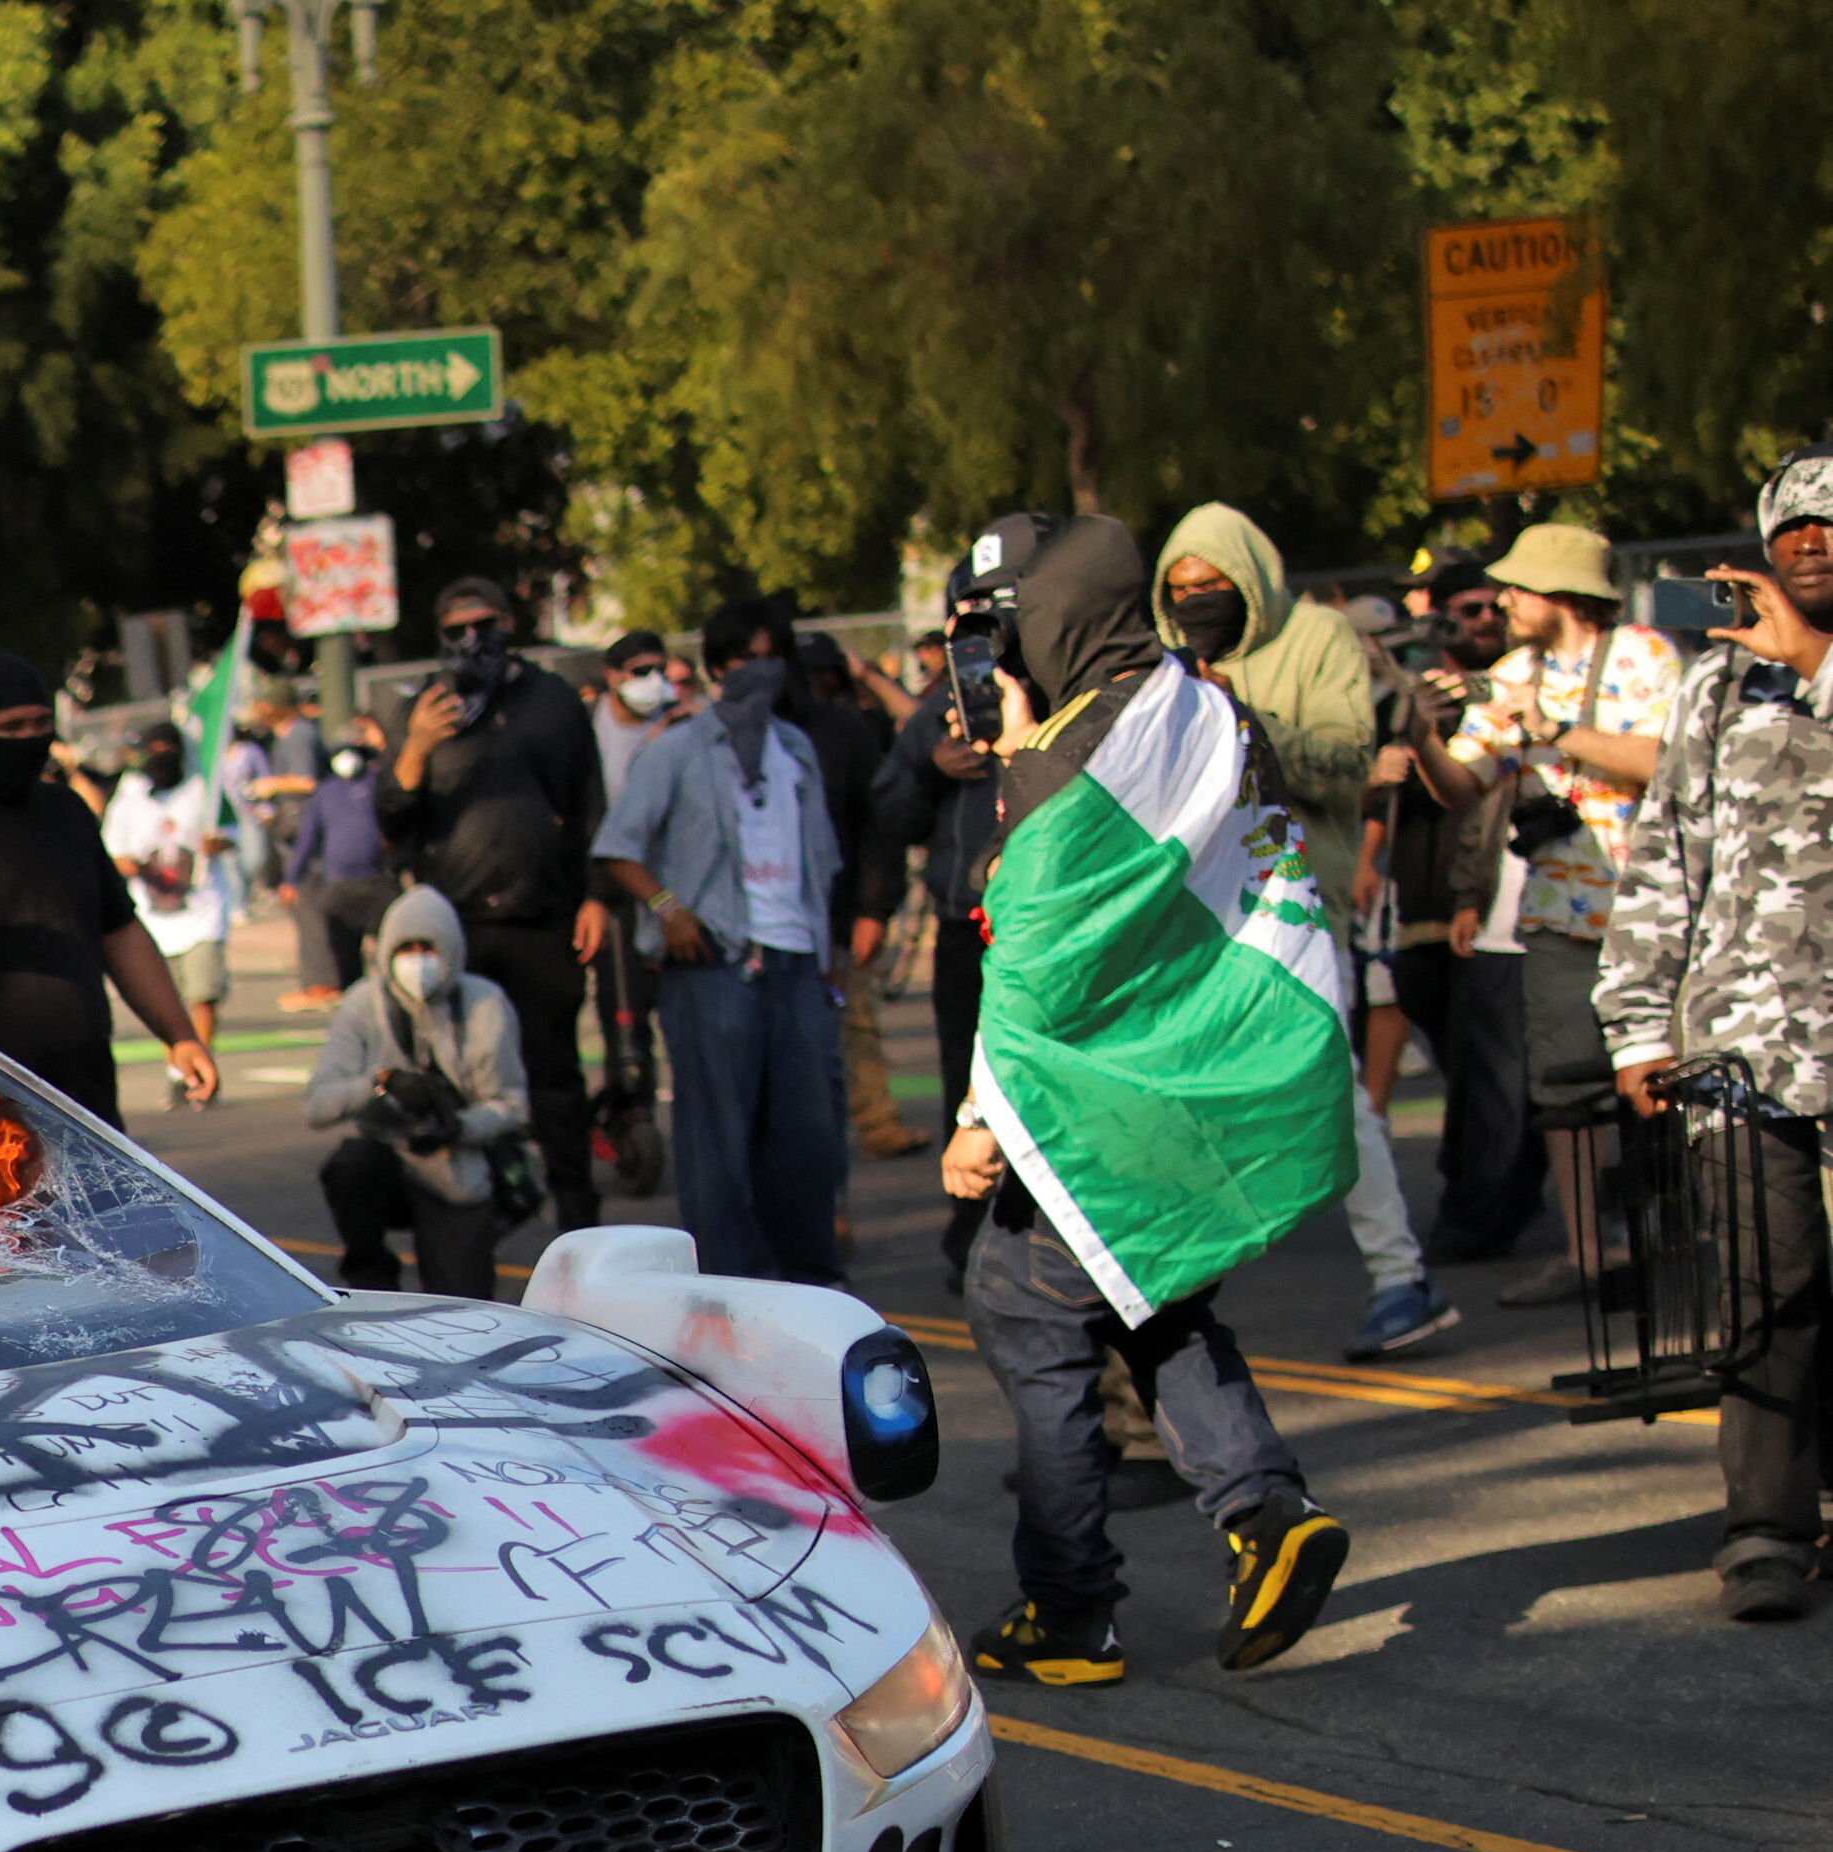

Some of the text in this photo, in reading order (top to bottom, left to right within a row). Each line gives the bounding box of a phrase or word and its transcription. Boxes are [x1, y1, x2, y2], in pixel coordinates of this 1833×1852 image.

[325, 361, 444, 403] NORTH
[291, 1632, 532, 1726] ICE
[581, 1584, 880, 1702] SCUM
[288, 1702, 502, 1753] JAGUAR
